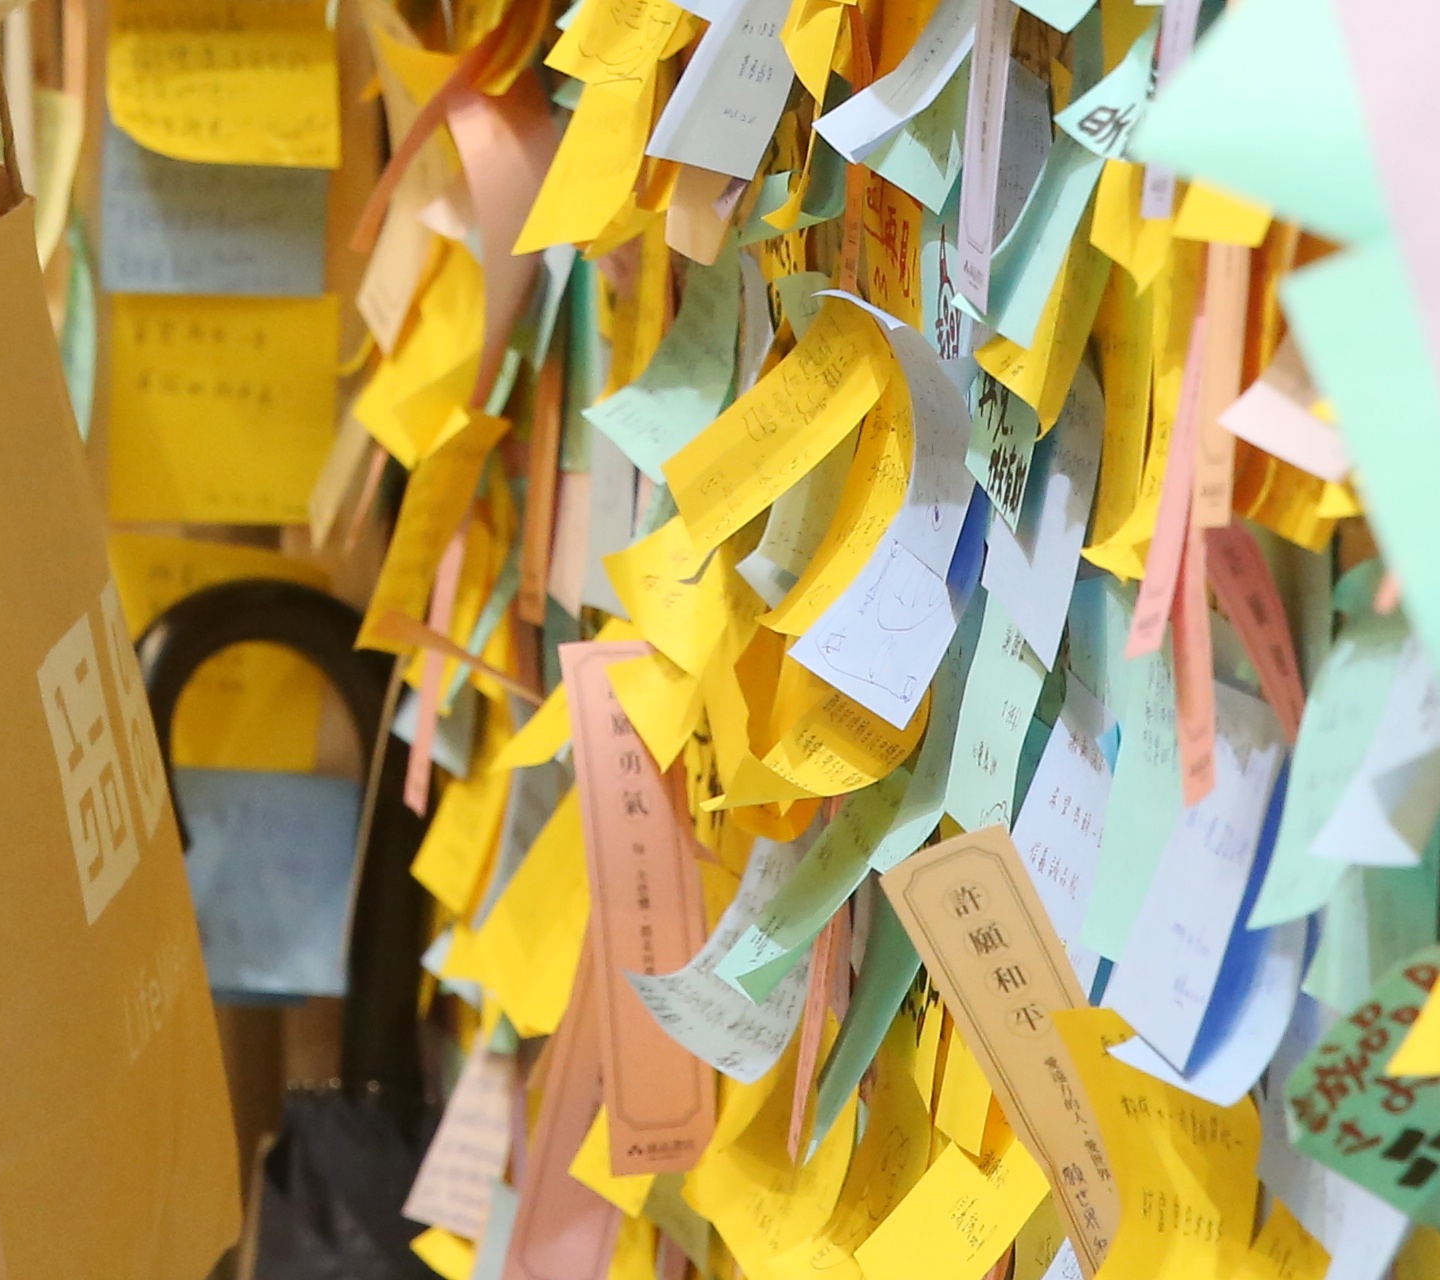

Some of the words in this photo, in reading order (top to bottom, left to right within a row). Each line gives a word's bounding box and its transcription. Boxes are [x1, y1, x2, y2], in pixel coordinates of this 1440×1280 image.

[947, 884, 1050, 1035] 許願和平
[1061, 1160, 1109, 1262] 願世界和
